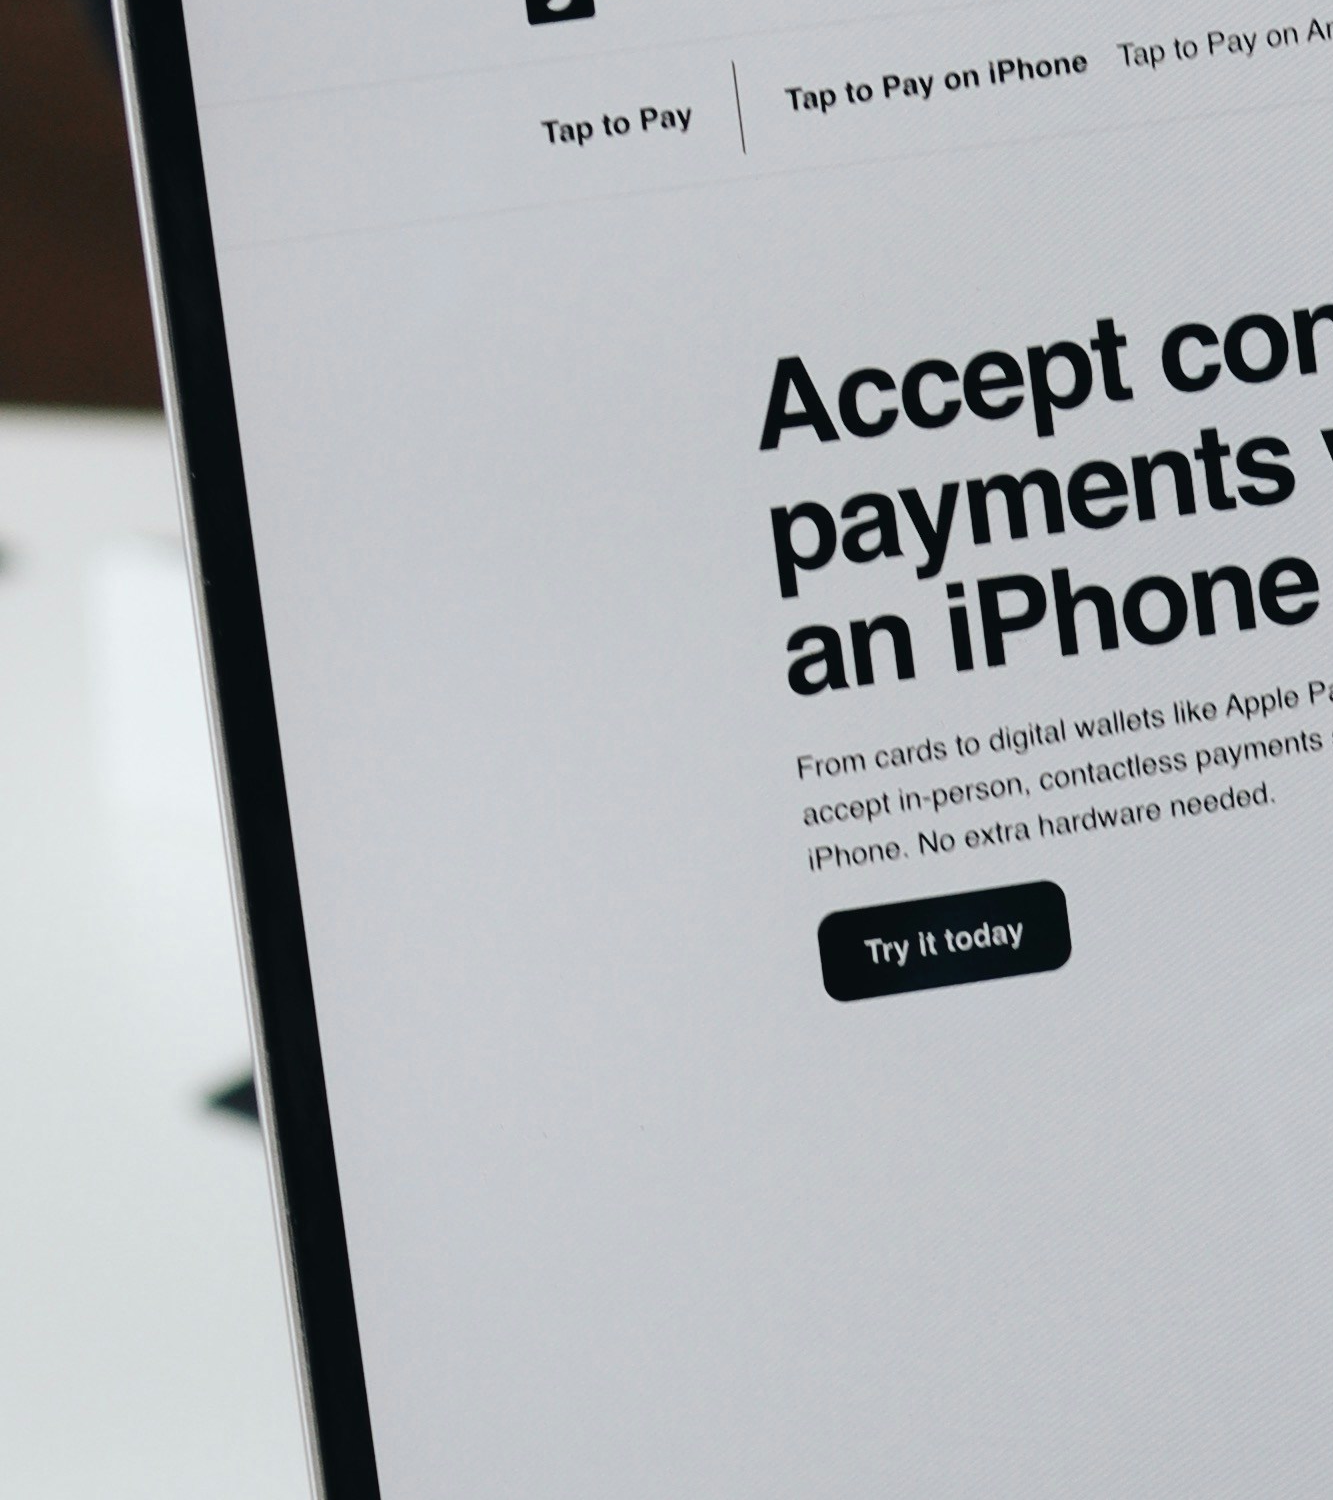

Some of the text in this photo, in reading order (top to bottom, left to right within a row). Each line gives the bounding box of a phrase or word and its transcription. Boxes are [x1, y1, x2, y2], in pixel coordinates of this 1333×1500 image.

[785, 56, 1087, 113] Tap to Pay on iPhone
[1119, 44, 1165, 69] Tap
[1174, 39, 1197, 59] to
[1208, 32, 1256, 55] Pay
[1267, 28, 1298, 47] on
[542, 108, 691, 146] Tap to Pay
[759, 318, 1133, 451] Accept
[771, 426, 1295, 598] payments
[787, 557, 1319, 695] an iPhone
[798, 754, 865, 779] From
[875, 739, 947, 768] cards
[956, 736, 979, 756] to
[990, 719, 1065, 754] digital
[1075, 709, 1164, 738] wallets
[1174, 701, 1216, 723] like
[1227, 688, 1298, 720] Apple
[804, 793, 890, 825] accept
[900, 778, 1029, 812] in-person,
[1040, 753, 1187, 790] contactless
[1196, 731, 1322, 773] payments
[809, 782, 1274, 870] iPhone. No extra hardware needed.
[864, 922, 1023, 966] Try it today
